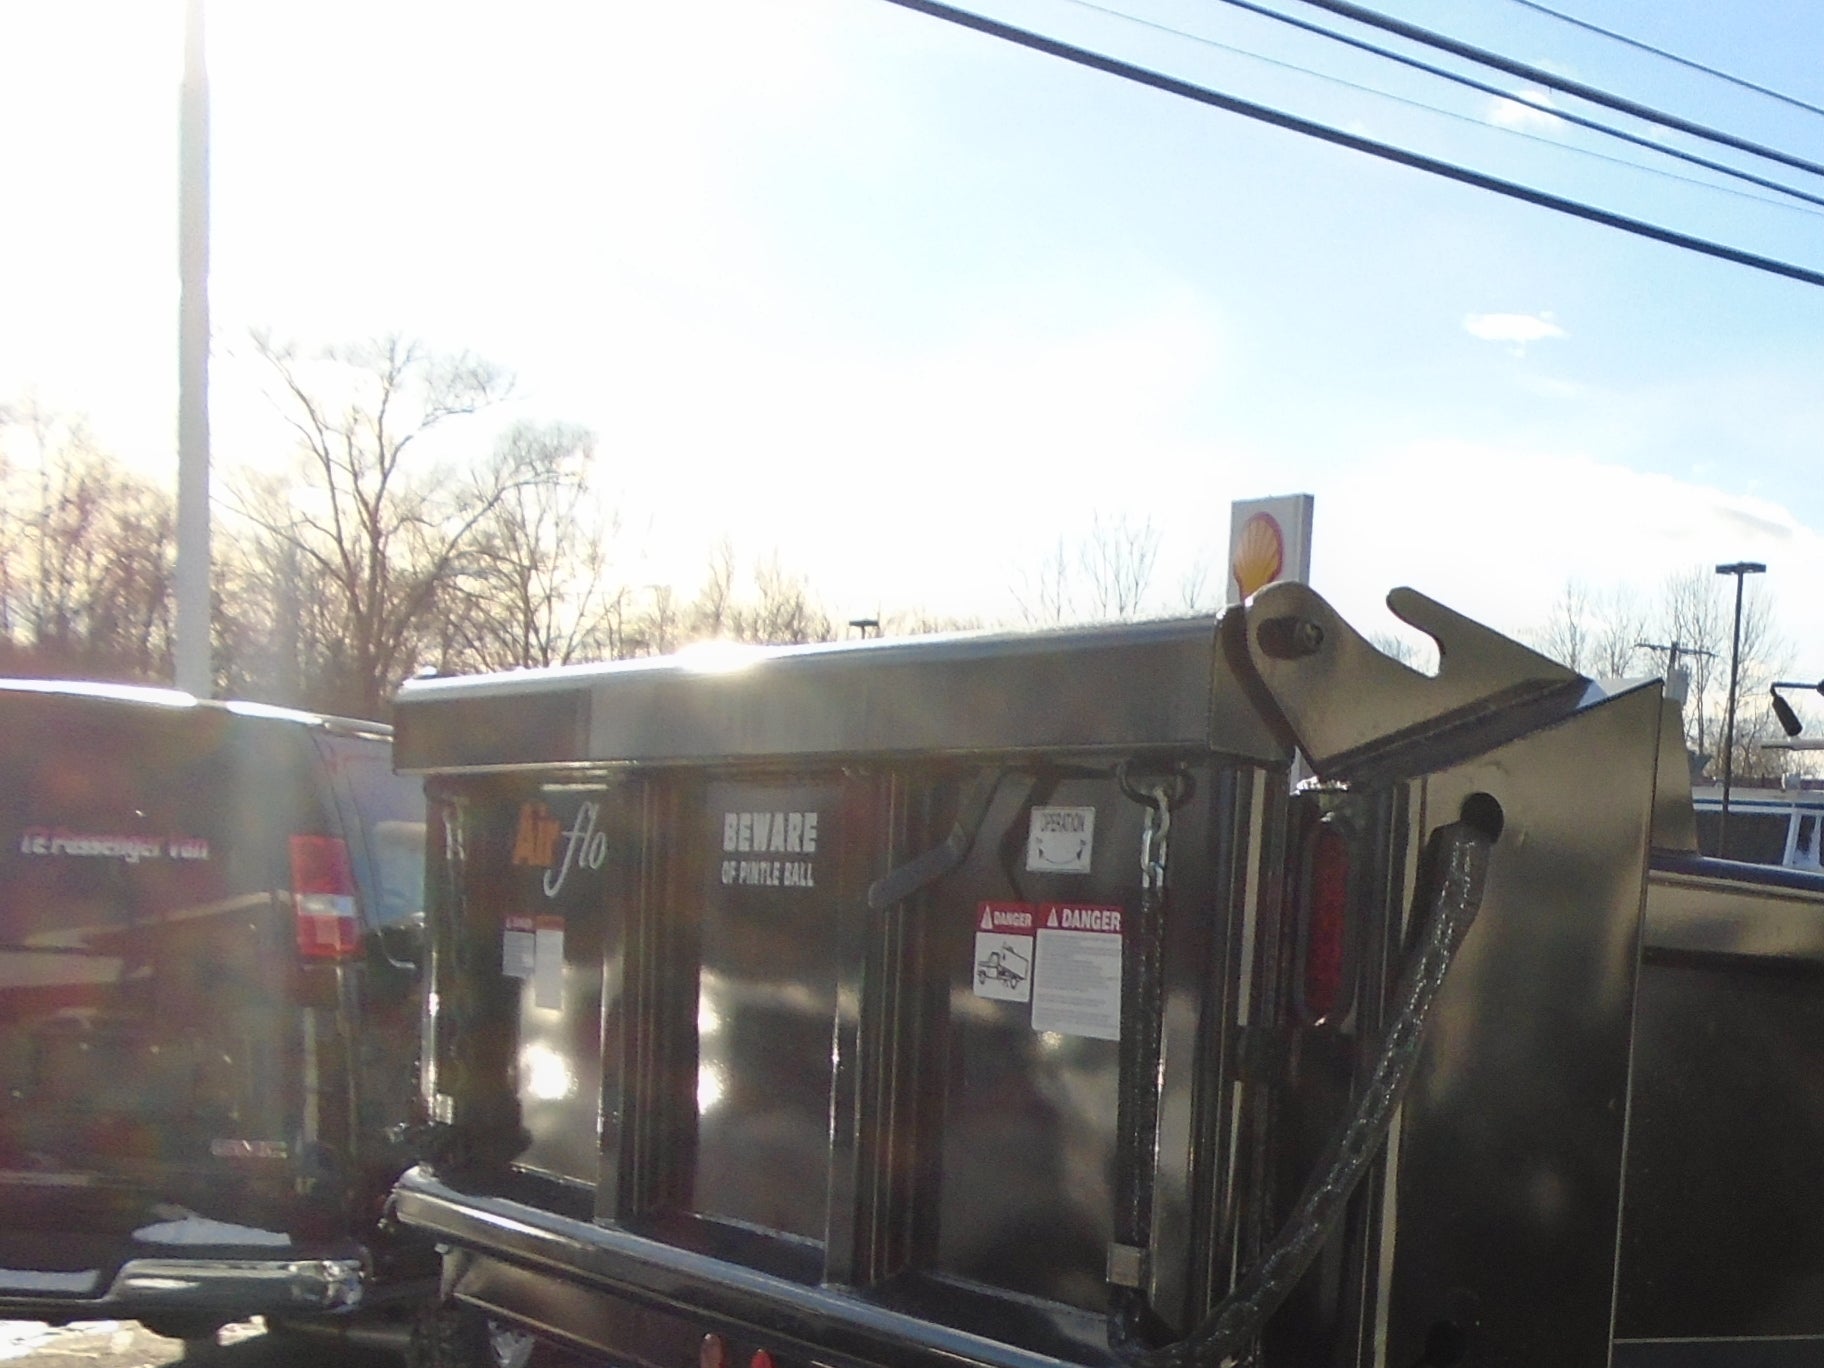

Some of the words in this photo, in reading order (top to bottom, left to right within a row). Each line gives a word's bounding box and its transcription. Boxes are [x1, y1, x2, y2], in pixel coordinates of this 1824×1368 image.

[723, 812, 818, 852] BEWARE
[721, 860, 737, 884] OF
[739, 861, 780, 886] PINTLE
[783, 862, 815, 887] BALL
[993, 911, 1033, 928] DANGER
[1061, 908, 1122, 931] DANGER
